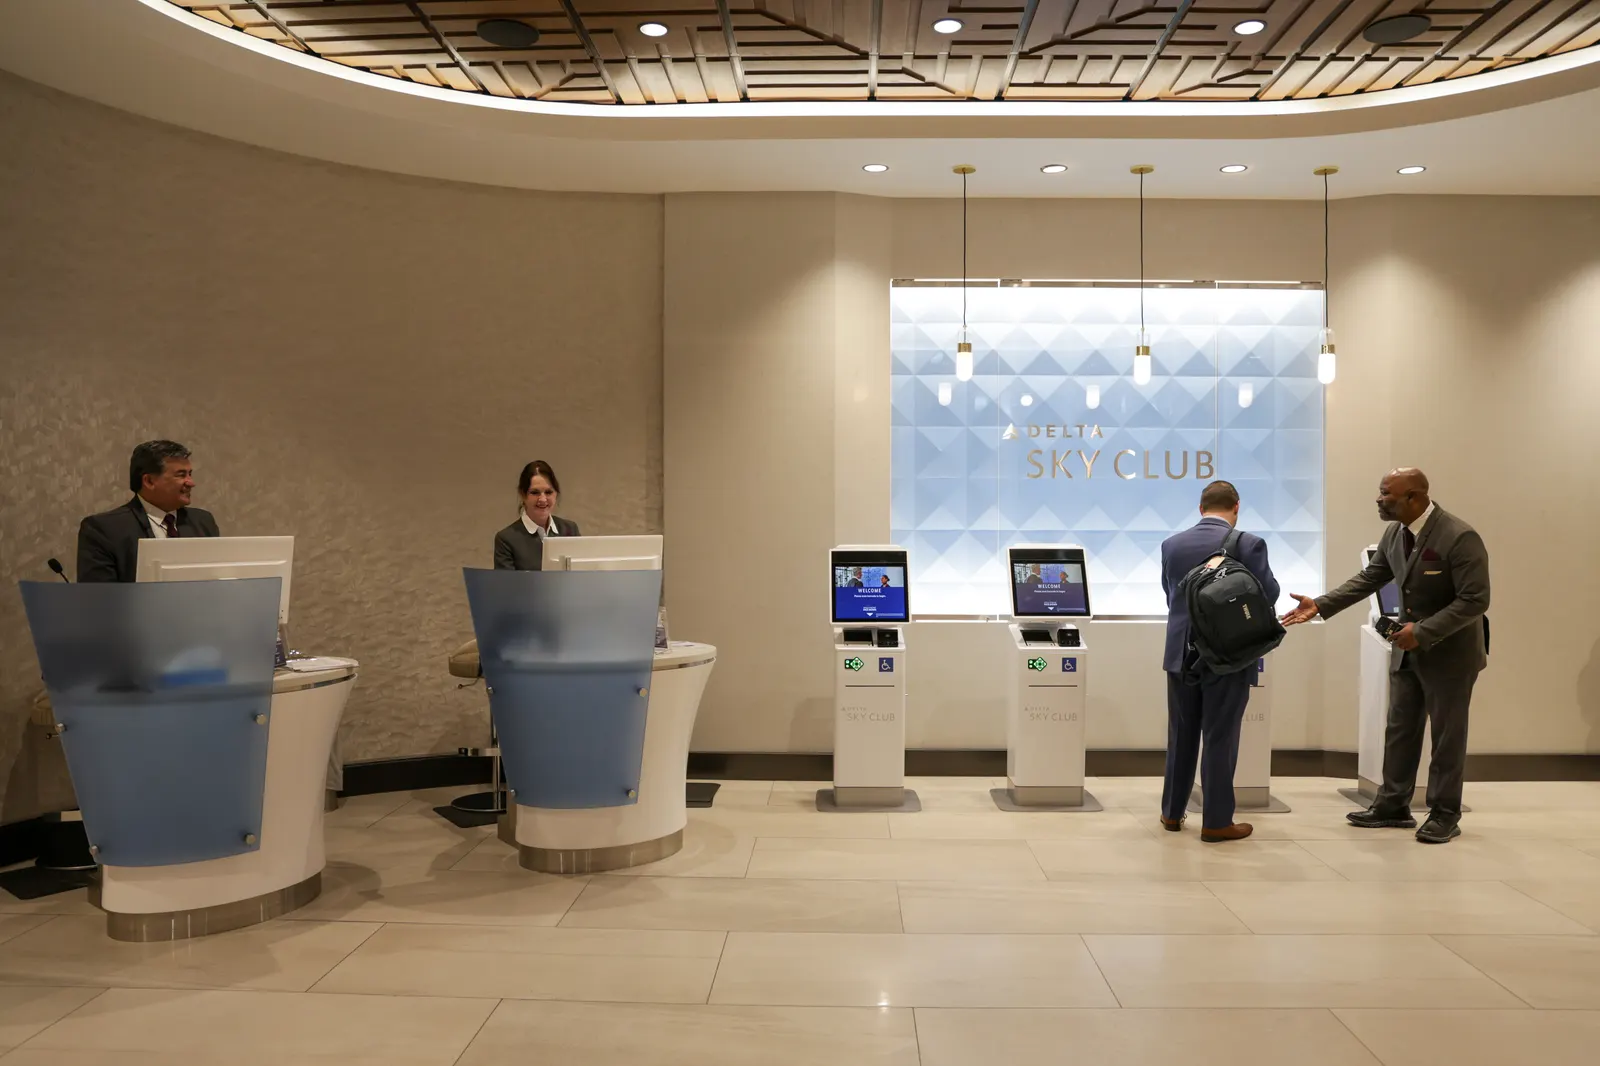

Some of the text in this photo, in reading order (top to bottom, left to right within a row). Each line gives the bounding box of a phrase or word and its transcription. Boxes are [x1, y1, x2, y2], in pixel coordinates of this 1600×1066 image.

[1027, 424, 1104, 439] DELTA
[1026, 449, 1215, 480] SKY CLUB
[847, 712, 895, 721] SKY CLUB
[1029, 712, 1077, 721] SKY CLUB
[1242, 713, 1265, 722] LUB
